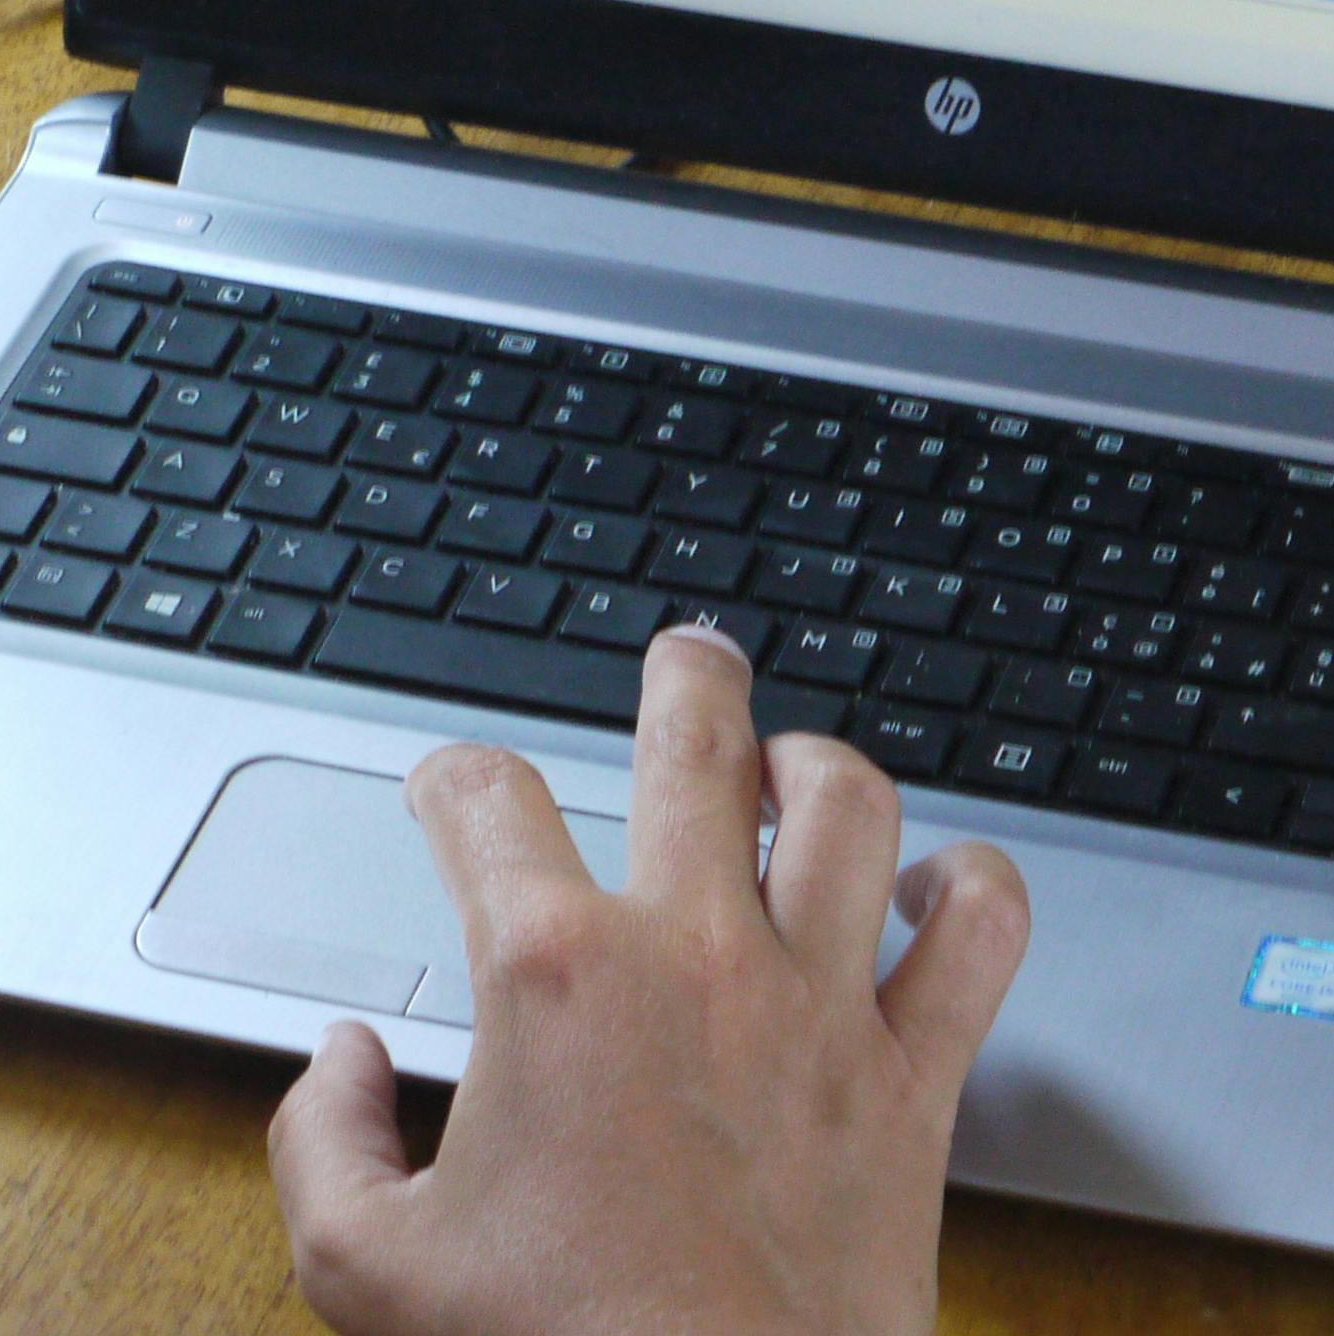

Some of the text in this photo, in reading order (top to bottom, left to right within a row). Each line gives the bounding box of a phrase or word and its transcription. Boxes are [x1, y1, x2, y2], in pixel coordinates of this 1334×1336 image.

[931, 76, 976, 136] hp
[177, 385, 201, 407] Q
[280, 401, 311, 425] W
[375, 419, 398, 443] E
[476, 436, 500, 459] R
[162, 449, 184, 471] A
[584, 453, 603, 475] T
[264, 466, 285, 489] S
[687, 470, 709, 492] Y
[365, 484, 389, 506] D
[787, 489, 811, 510] U
[467, 501, 491, 522] F
[174, 518, 200, 541] Z
[572, 519, 596, 542] G
[277, 537, 303, 560] X
[674, 535, 700, 560] H
[1101, 543, 1124, 564] P
[381, 555, 405, 578] C
[780, 556, 802, 577] J
[489, 572, 512, 596] V
[885, 574, 910, 598] K
[243, 605, 265, 621] alt
[588, 590, 611, 614] B
[991, 591, 1009, 616] L
[694, 608, 719, 632] N
[800, 627, 829, 654] M
[879, 719, 924, 740] alt gr
[1098, 756, 1129, 776] ctrl
